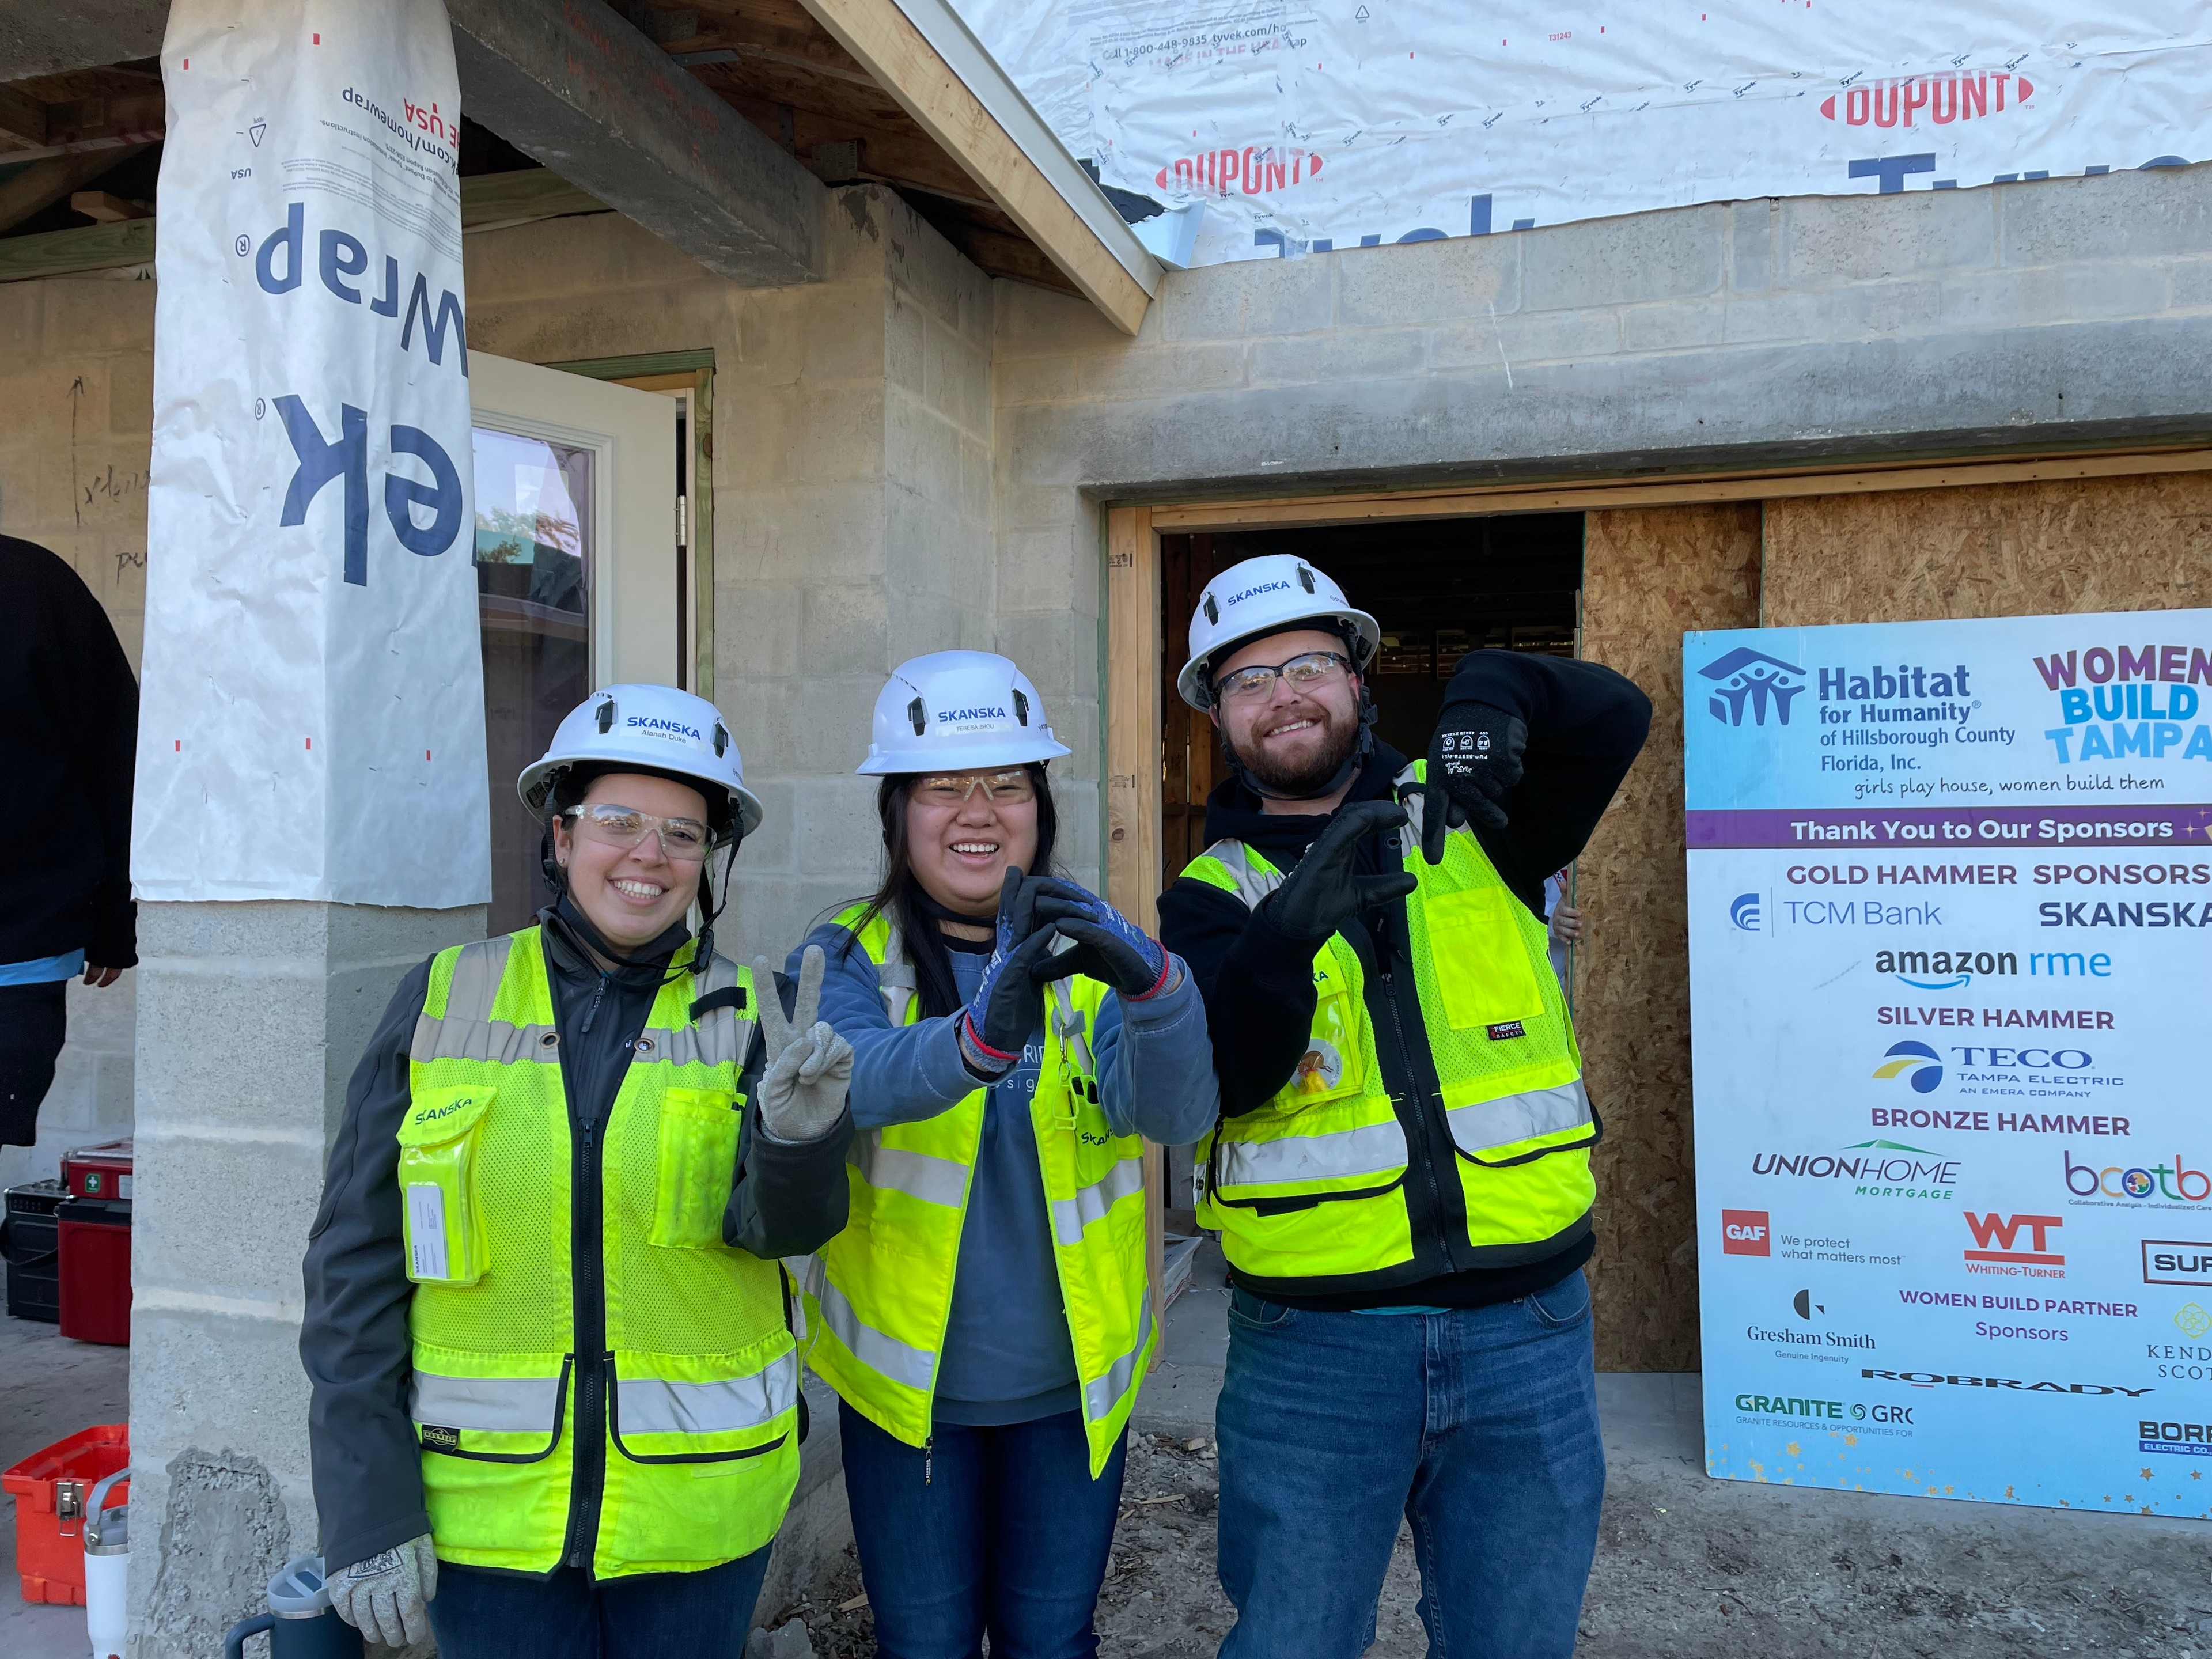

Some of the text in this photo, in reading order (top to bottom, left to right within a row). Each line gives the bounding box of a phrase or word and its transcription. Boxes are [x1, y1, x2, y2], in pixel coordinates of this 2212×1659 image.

[1124, 35, 1207, 57] 1-800-448-9835
[1548, 31, 1572, 41] T31243
[1847, 70, 2010, 128] DUPONT
[403, 98, 443, 139] USA
[319, 120, 362, 141] instructions.
[231, 168, 251, 180] USA
[1174, 146, 1305, 196] DUPONT
[1227, 579, 1291, 607] SKANSKA
[2032, 645, 2212, 691] WOMEN
[1819, 664, 1971, 701] Habitat
[938, 707, 1006, 723] SKANSKA
[1820, 705, 1852, 724] for
[2059, 684, 2199, 725] BUILD
[627, 717, 701, 741] SKANSKA
[641, 729, 687, 744] Alanah Duke
[1820, 726, 2016, 748] of Hillsborough County
[2044, 722, 2212, 764] TAMPA
[1821, 753, 1922, 773] Florida, Inc.
[1854, 774, 2165, 800] girls play house, women build them
[1790, 819, 2174, 844] Thank You to Our Sponsors
[1786, 863, 2211, 885] GOLD HAMMER SPONSORS
[1783, 900, 1942, 926] TCM Bank
[2039, 902, 2212, 927] SKANSKA
[1875, 949, 2112, 978] amazon rme
[1493, 1022, 1521, 1033] FIERCE
[1877, 1006, 2115, 1030] SILVER HAMMER
[1495, 1030, 1523, 1039] SAFETY
[1951, 1046, 2093, 1070] TECO
[1957, 1073, 2125, 1086] TAMPA ELECTRIC
[1981, 1088, 2025, 1096] EMERA
[2029, 1089, 2092, 1098] COMPANY
[414, 1098, 472, 1126] SANSKA
[1871, 1107, 2131, 1137] BRONZE HAMMER
[1855, 1185, 1955, 1200] MORTGAGE
[2068, 1199, 2114, 1207] Collaborative
[2116, 1201, 2142, 1209] Analysis
[2148, 1202, 2195, 1211] Individualized
[1726, 1224, 1766, 1241] GAF
[1781, 1234, 1850, 1249] We protect
[1963, 1211, 2063, 1252] WT
[1781, 1248, 1813, 1260] what
[1817, 1251, 1865, 1263] matters
[1965, 1263, 2066, 1279] WHITING-TURNER
[1899, 1289, 2138, 1318] WOMEN BUILD PARTNER
[1747, 1325, 1876, 1349] Gresham Smith
[1975, 1321, 2069, 1342] Sponsors
[1775, 1350, 1849, 1364] Genuine Ingenuity
[1861, 1369, 2156, 1397] ROBRADY
[1736, 1394, 1843, 1419] GRANITE
[1736, 1416, 1771, 1426] GRANITE
[1773, 1419, 1820, 1431] RESOURCES
[1829, 1425, 1894, 1436] OPPORTUNITIES
[1896, 1429, 1913, 1438] FOR
[2143, 1442, 2191, 1453] ELECTRIC
